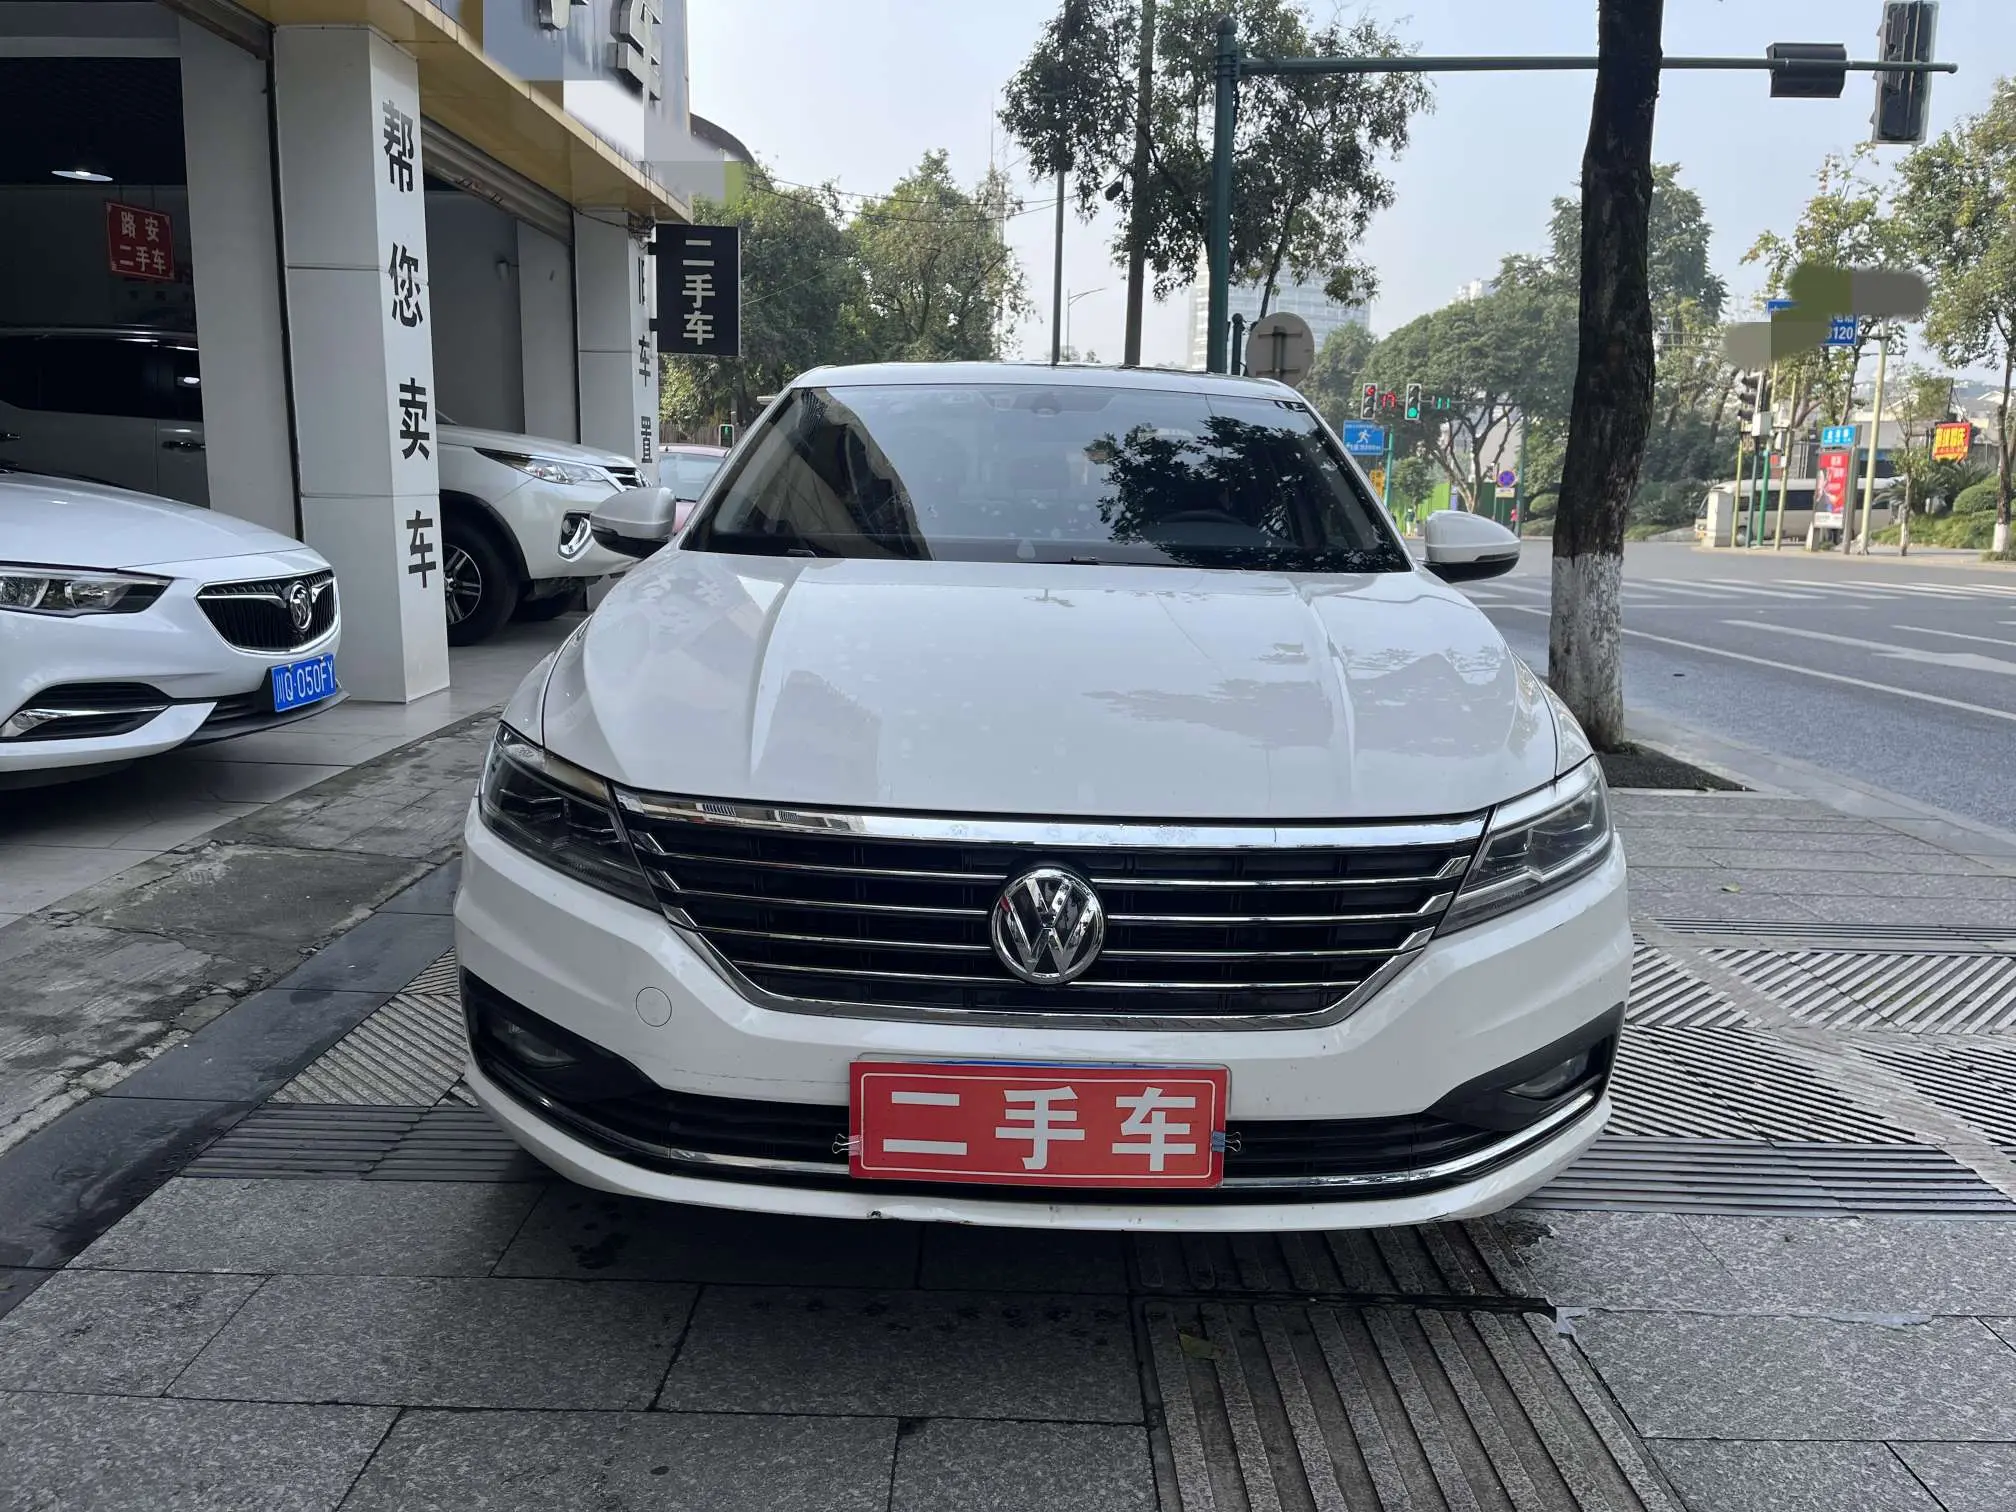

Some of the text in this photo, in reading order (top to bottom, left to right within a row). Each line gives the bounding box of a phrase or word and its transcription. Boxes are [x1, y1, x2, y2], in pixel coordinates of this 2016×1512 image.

[120, 245, 166, 275] 二手车
[121, 211, 160, 243] 路安
[682, 239, 716, 346] 二手车
[382, 99, 437, 589] 帮您卖车
[882, 1085, 1197, 1172] 二手车
